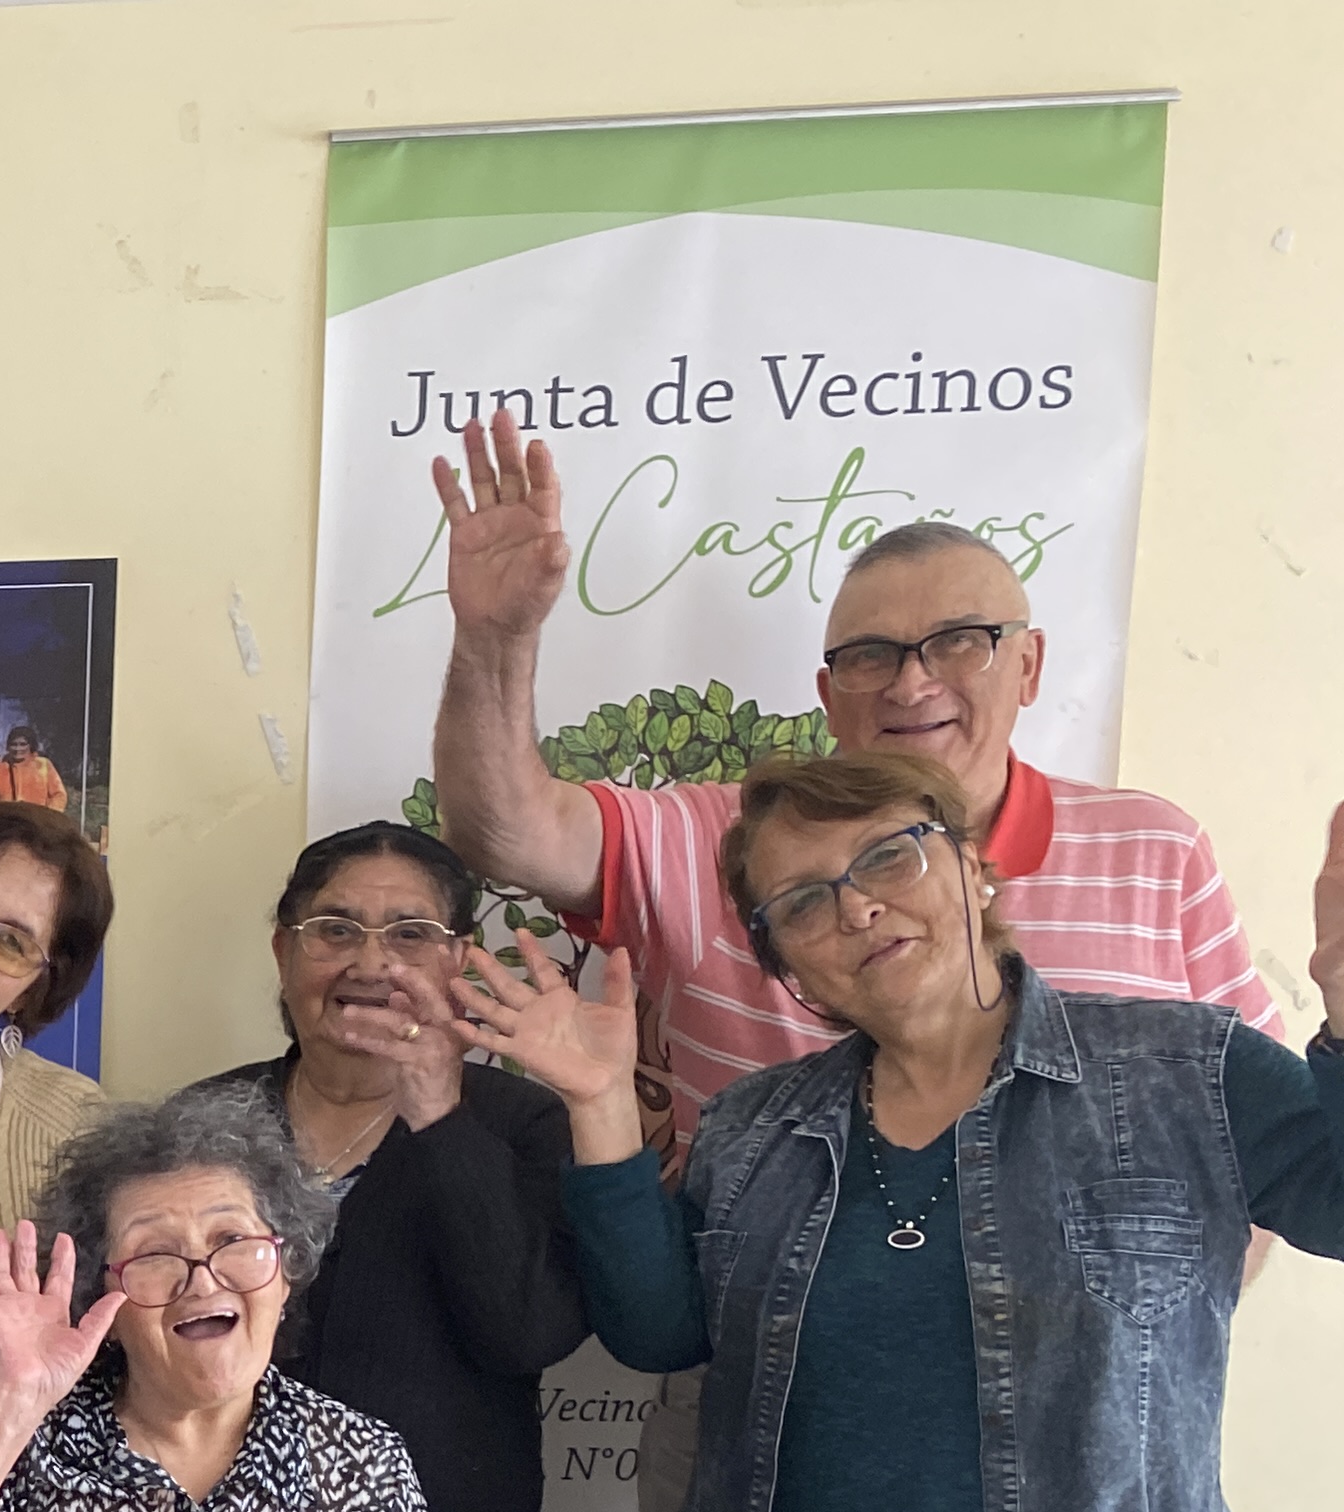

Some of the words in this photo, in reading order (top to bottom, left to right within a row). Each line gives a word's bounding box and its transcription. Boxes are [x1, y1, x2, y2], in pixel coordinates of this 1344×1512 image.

[390, 370, 619, 437] Junta
[646, 355, 735, 426] de
[761, 351, 1074, 421] Vecinos
[578, 446, 1075, 616] Castaos
